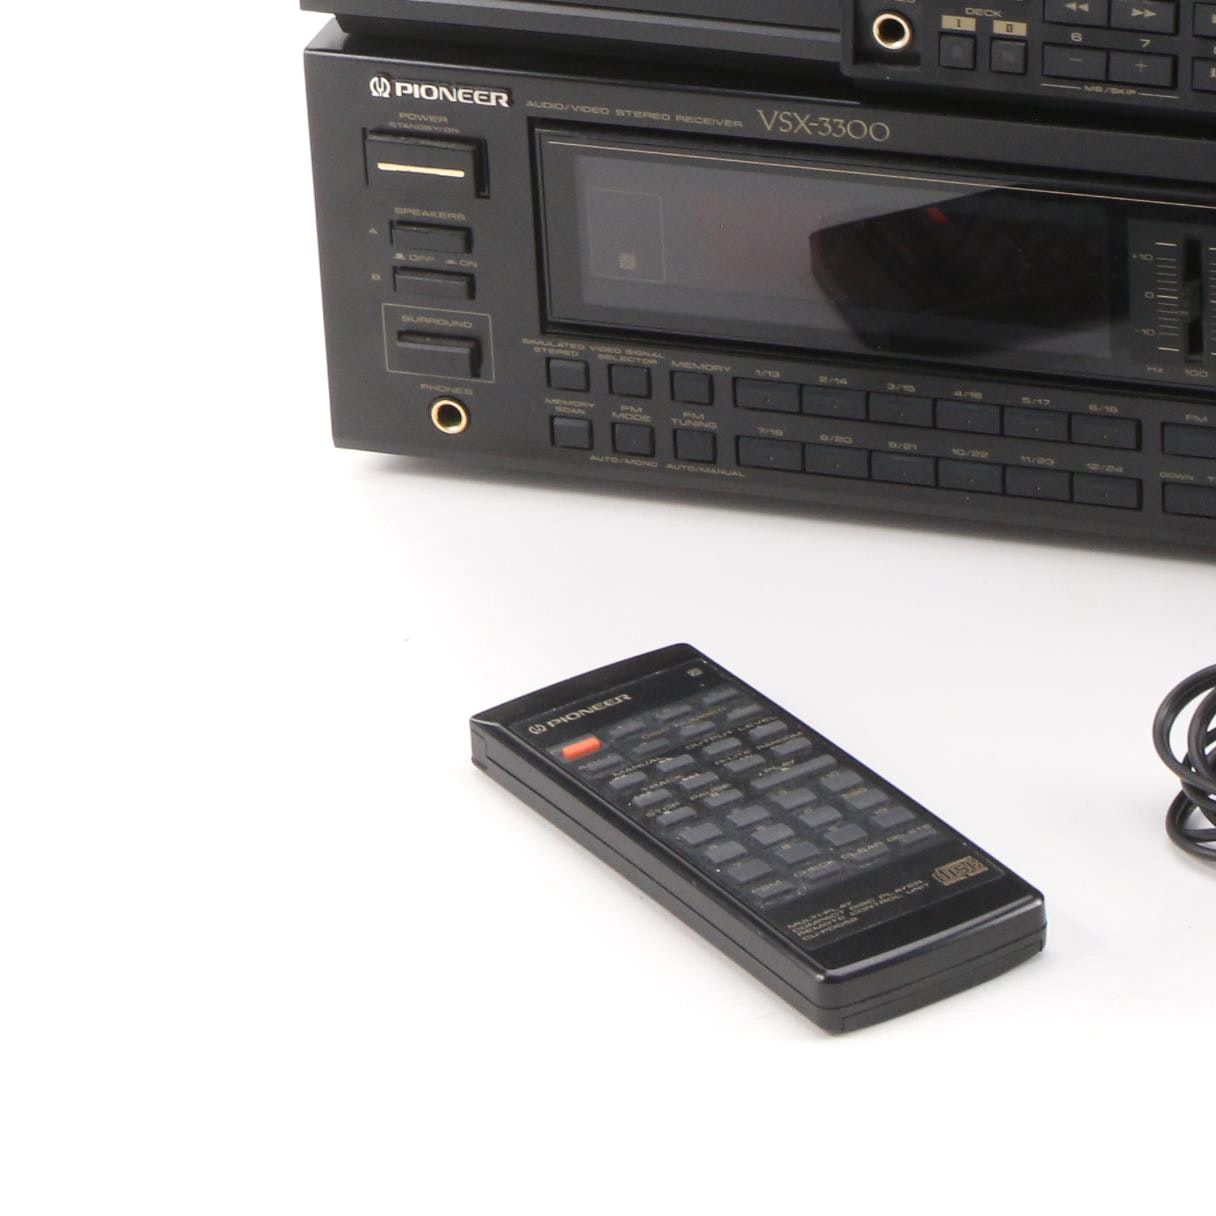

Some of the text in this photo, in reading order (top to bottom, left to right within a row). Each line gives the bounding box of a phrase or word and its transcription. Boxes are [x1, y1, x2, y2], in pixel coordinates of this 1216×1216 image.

[965, 7, 1003, 18] DECK
[1071, 32, 1083, 42] 6
[1139, 38, 1151, 48] 7
[395, 81, 891, 143] PIONEER AUDIO/VIDEO STEREO RECEIVER VSX-3300
[398, 111, 448, 124] POWER
[394, 206, 467, 221] SPEAKERS
[400, 314, 473, 330] SURROUND
[521, 338, 664, 360] SIMULATED VIDEO SIGNAL
[533, 346, 580, 358] STEREO
[598, 353, 658, 366] SELECTOR
[670, 360, 733, 373] MEMORY
[754, 368, 781, 379] 1/13
[544, 396, 596, 409] MEMORY
[554, 405, 586, 416] SCAN
[612, 411, 652, 423] MODE
[670, 417, 718, 430] TUNING
[589, 454, 658, 468] AUTO/MONO
[666, 462, 746, 478] AUTO/MANUAL
[1159, 470, 1195, 482] DOWN
[548, 693, 632, 729] PIONEER
